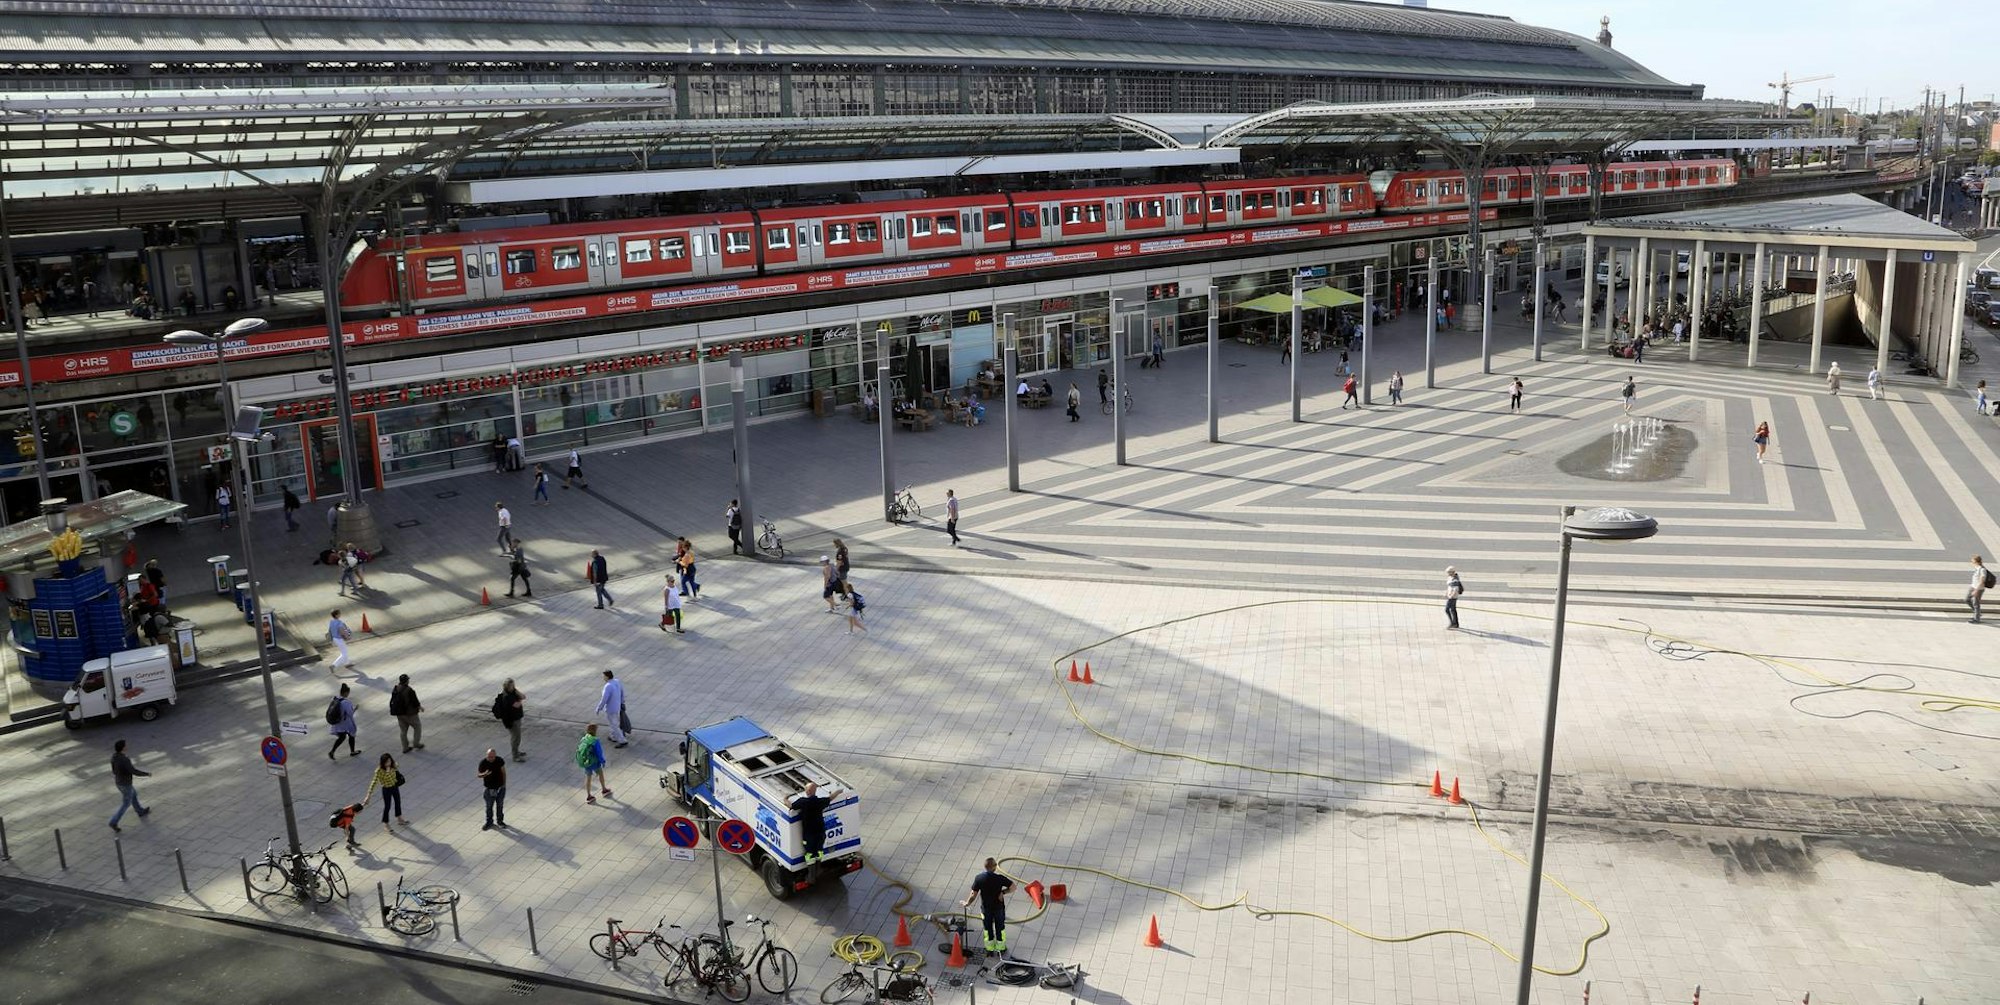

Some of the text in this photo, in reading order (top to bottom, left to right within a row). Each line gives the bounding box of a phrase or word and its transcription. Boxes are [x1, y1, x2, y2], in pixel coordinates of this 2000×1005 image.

[617, 296, 637, 304] HRS
[375, 323, 399, 332] HRS
[80, 357, 108, 367] HRS
[132, 347, 181, 359] EINCHECKEN
[134, 357, 166, 367] EINMAL
[236, 344, 266, 355] WIEDER
[267, 340, 311, 351] FORMULARE
[423, 350, 682, 397] INTERNATIONAL PHARMACY
[275, 390, 389, 420] APOTEKE
[115, 414, 133, 434] S
[756, 821, 781, 848] JADON
